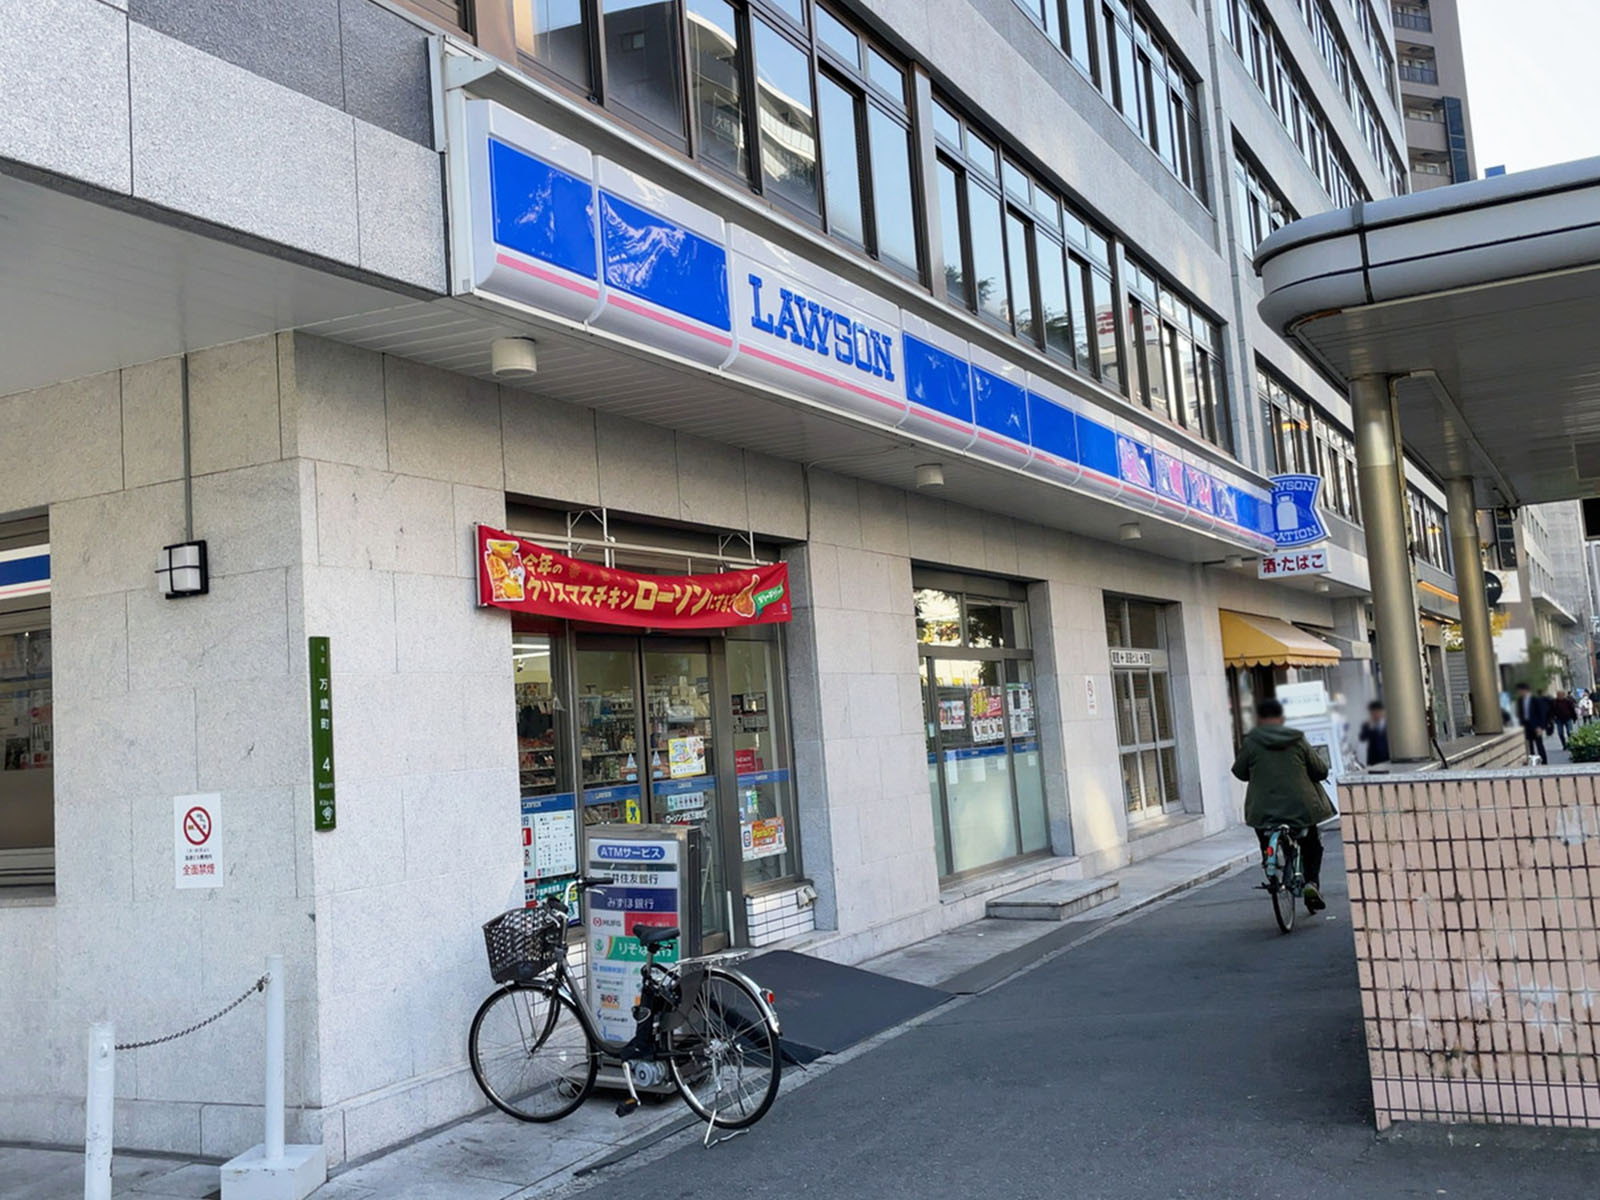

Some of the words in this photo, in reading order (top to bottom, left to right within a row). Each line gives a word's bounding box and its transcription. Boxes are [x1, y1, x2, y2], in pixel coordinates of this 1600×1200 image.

[748, 273, 894, 382] LAWSON
[1268, 481, 1314, 493] WSON
[1272, 524, 1318, 542] ATION
[522, 552, 563, 576] 今年の
[322, 757, 330, 772] 4
[600, 846, 662, 859] ATMサービス
[607, 897, 655, 910] みずほ銀行
[619, 941, 673, 958] りそな行
